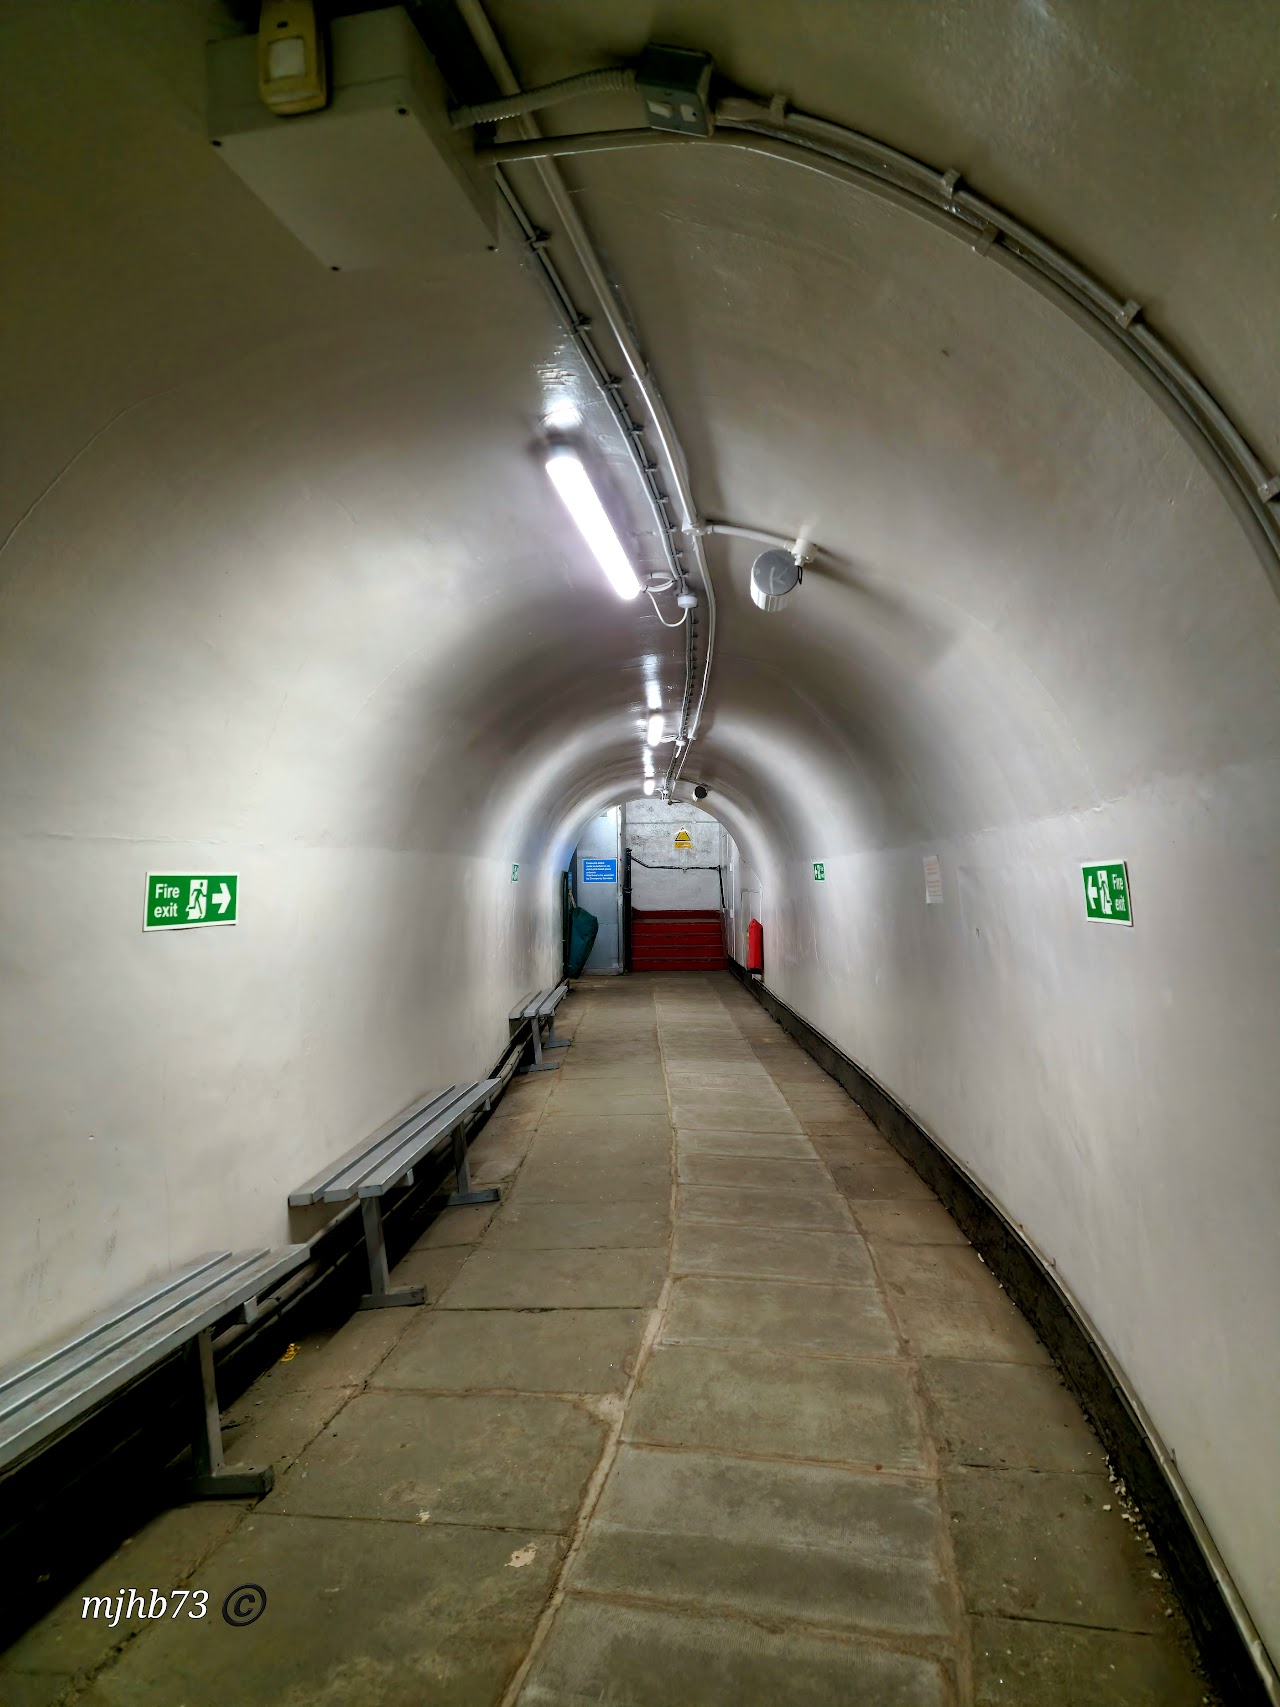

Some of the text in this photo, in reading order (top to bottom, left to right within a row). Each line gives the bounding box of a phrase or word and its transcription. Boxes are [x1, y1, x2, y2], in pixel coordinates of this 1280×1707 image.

[1111, 873, 1124, 890] Fire
[155, 883, 180, 899] Fire
[154, 902, 178, 918] exit
